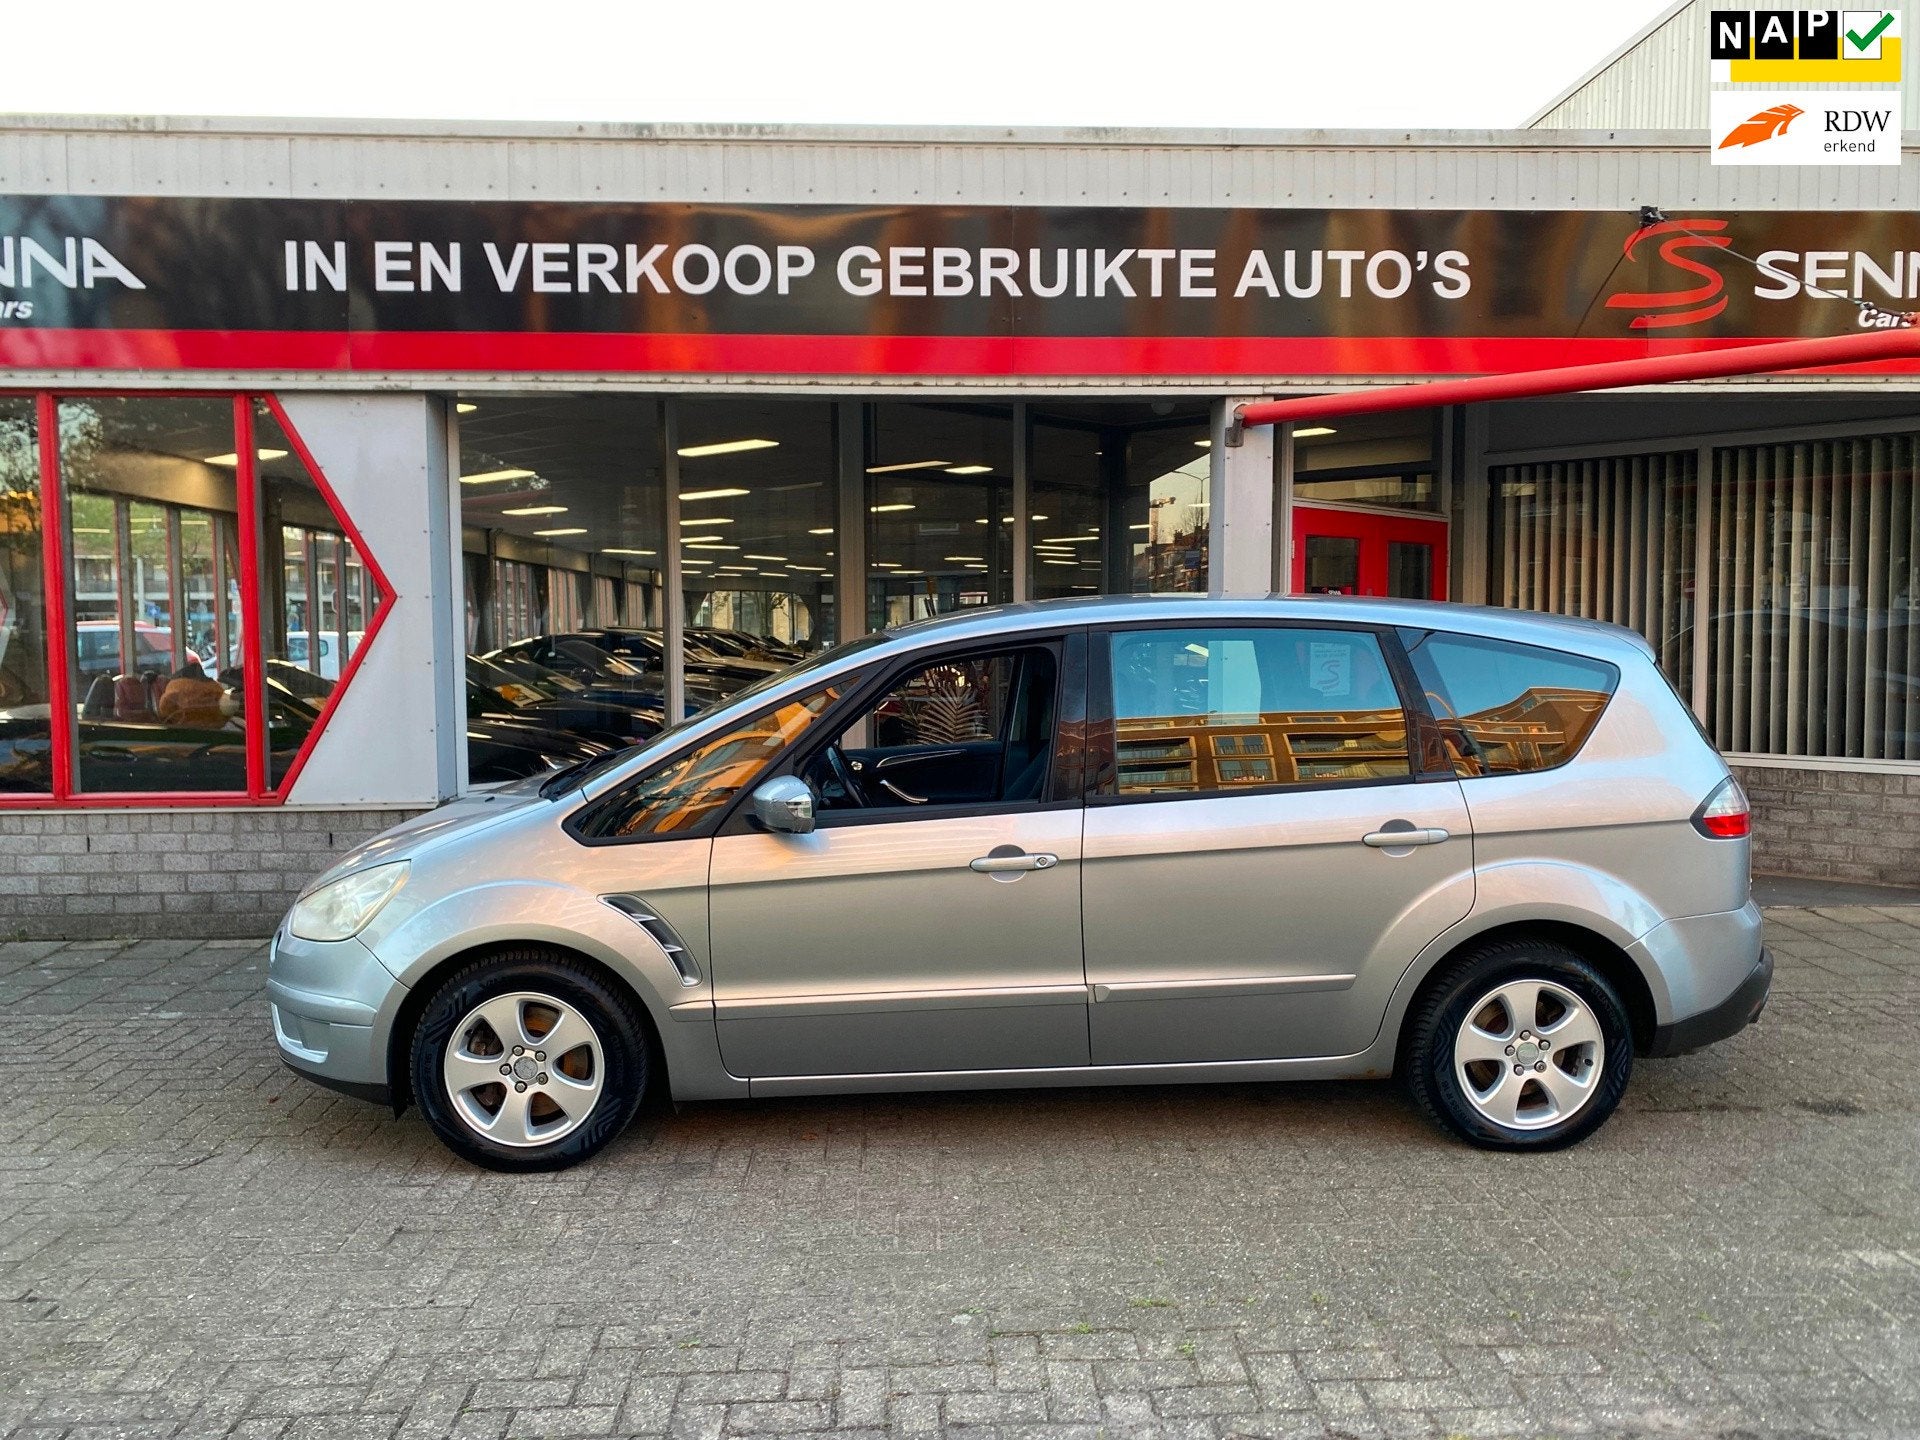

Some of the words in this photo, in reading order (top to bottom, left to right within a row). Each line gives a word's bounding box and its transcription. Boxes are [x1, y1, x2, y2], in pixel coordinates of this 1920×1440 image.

[0, 236, 147, 289] NA
[285, 241, 347, 292] IN
[374, 242, 461, 292] EN
[483, 243, 815, 295] VERKOOP
[836, 246, 1217, 297] GEBRUIKTE
[1233, 250, 1471, 298] AUTO'S
[1754, 250, 1920, 300] SEN
[0, 300, 34, 319] rs
